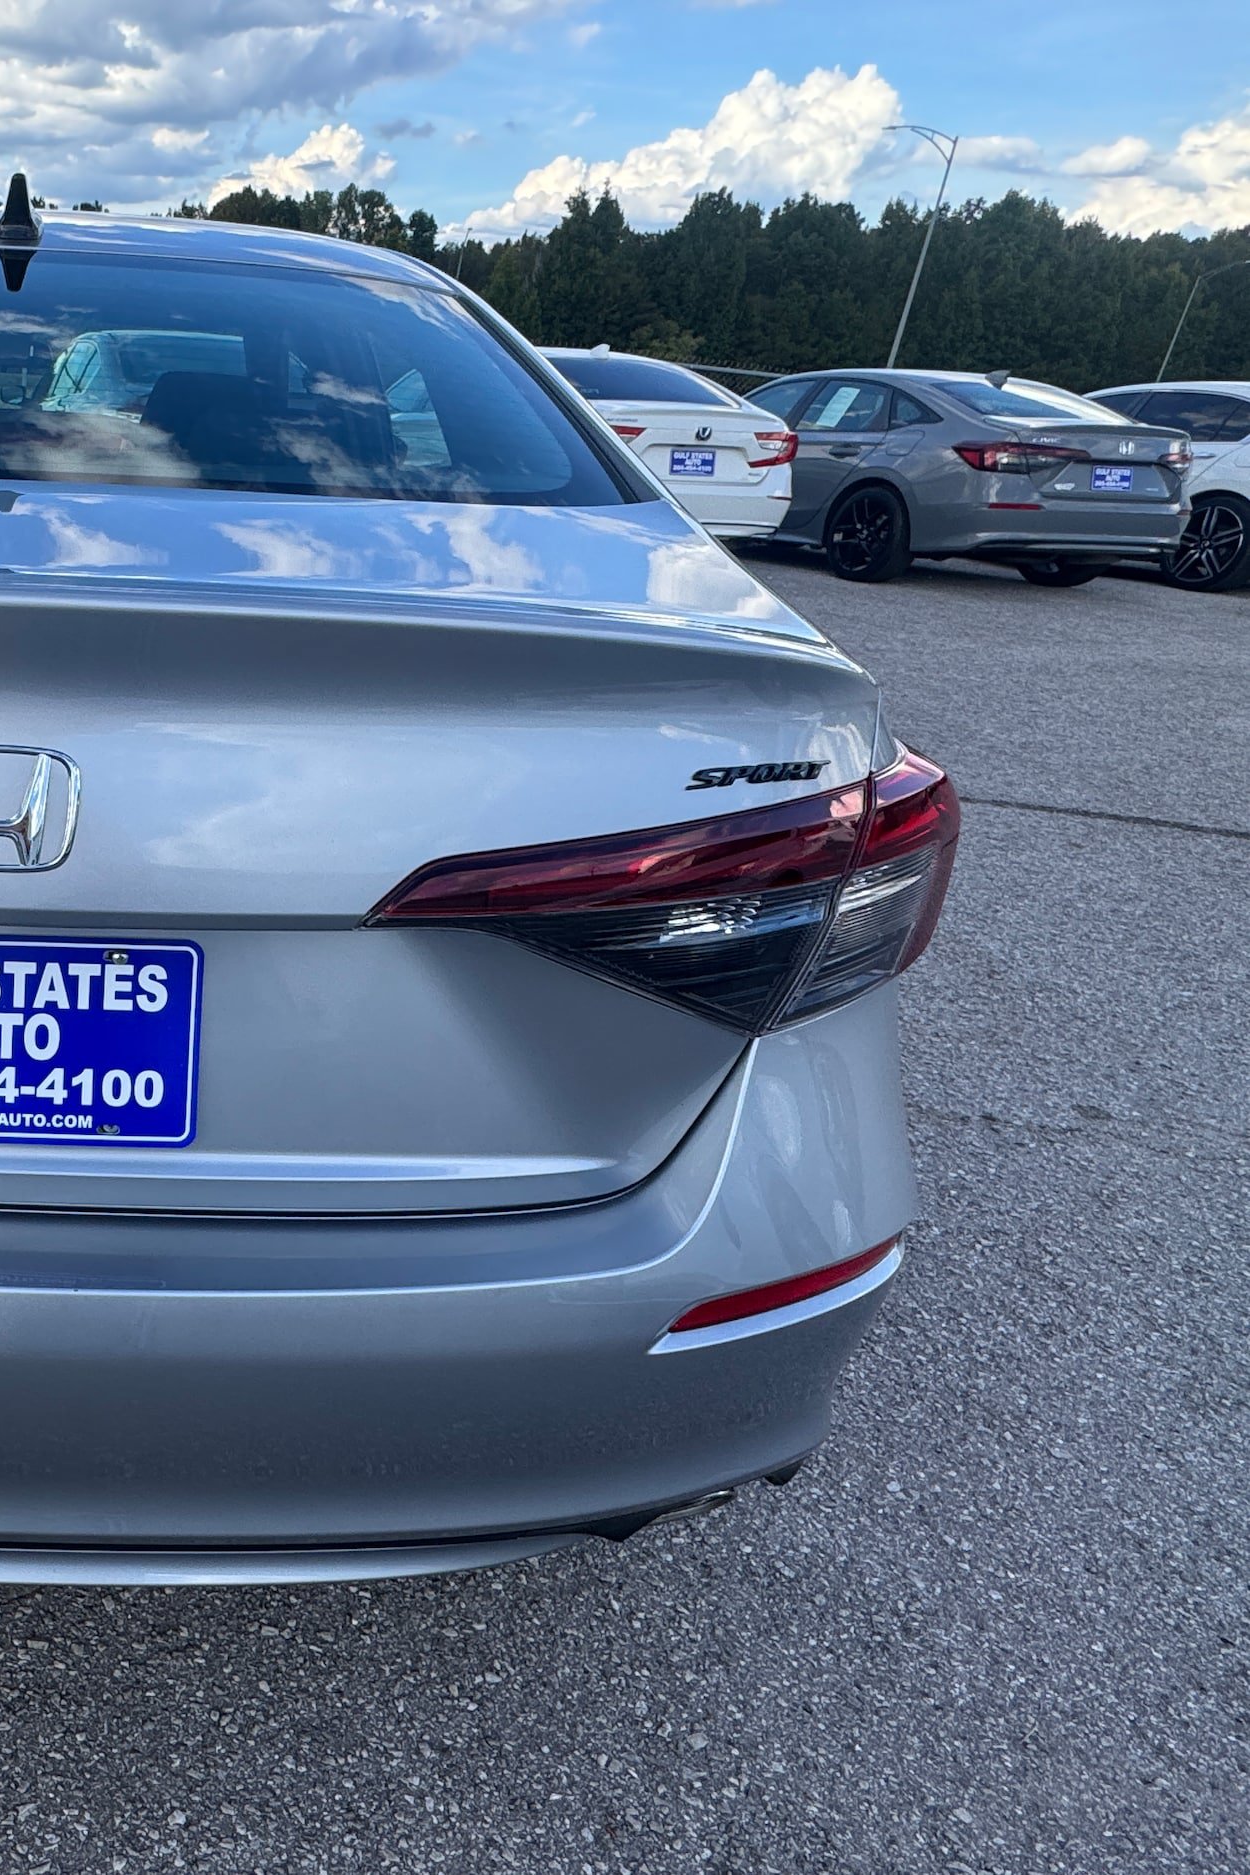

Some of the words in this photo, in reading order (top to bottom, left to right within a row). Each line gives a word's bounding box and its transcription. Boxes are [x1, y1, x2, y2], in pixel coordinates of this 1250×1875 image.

[673, 451, 690, 460] GULF
[691, 452, 713, 460] STATES
[685, 760, 831, 791] SPORT
